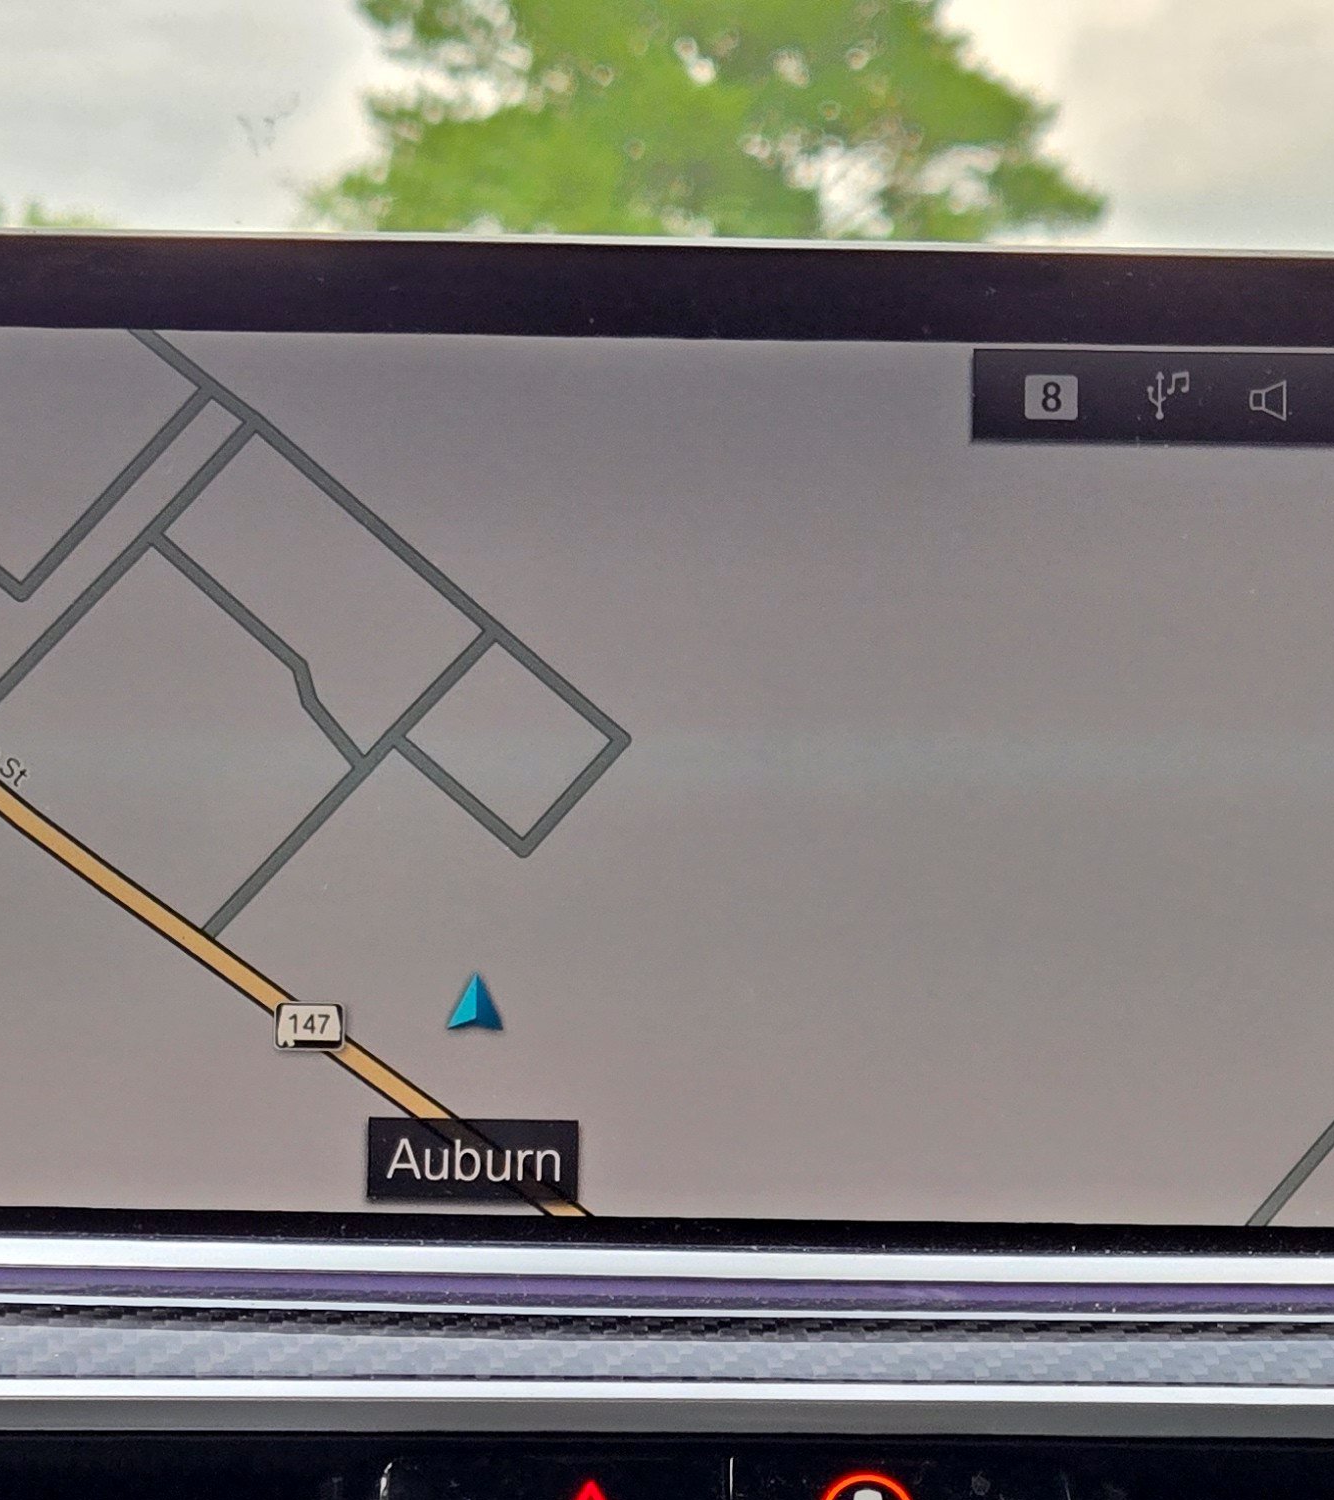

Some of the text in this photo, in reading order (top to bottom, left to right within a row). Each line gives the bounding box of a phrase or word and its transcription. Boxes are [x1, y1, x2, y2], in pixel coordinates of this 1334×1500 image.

[1041, 382, 1062, 414] 8
[0, 757, 28, 787] St
[288, 1014, 331, 1035] 147
[386, 1136, 562, 1183] Auburn
